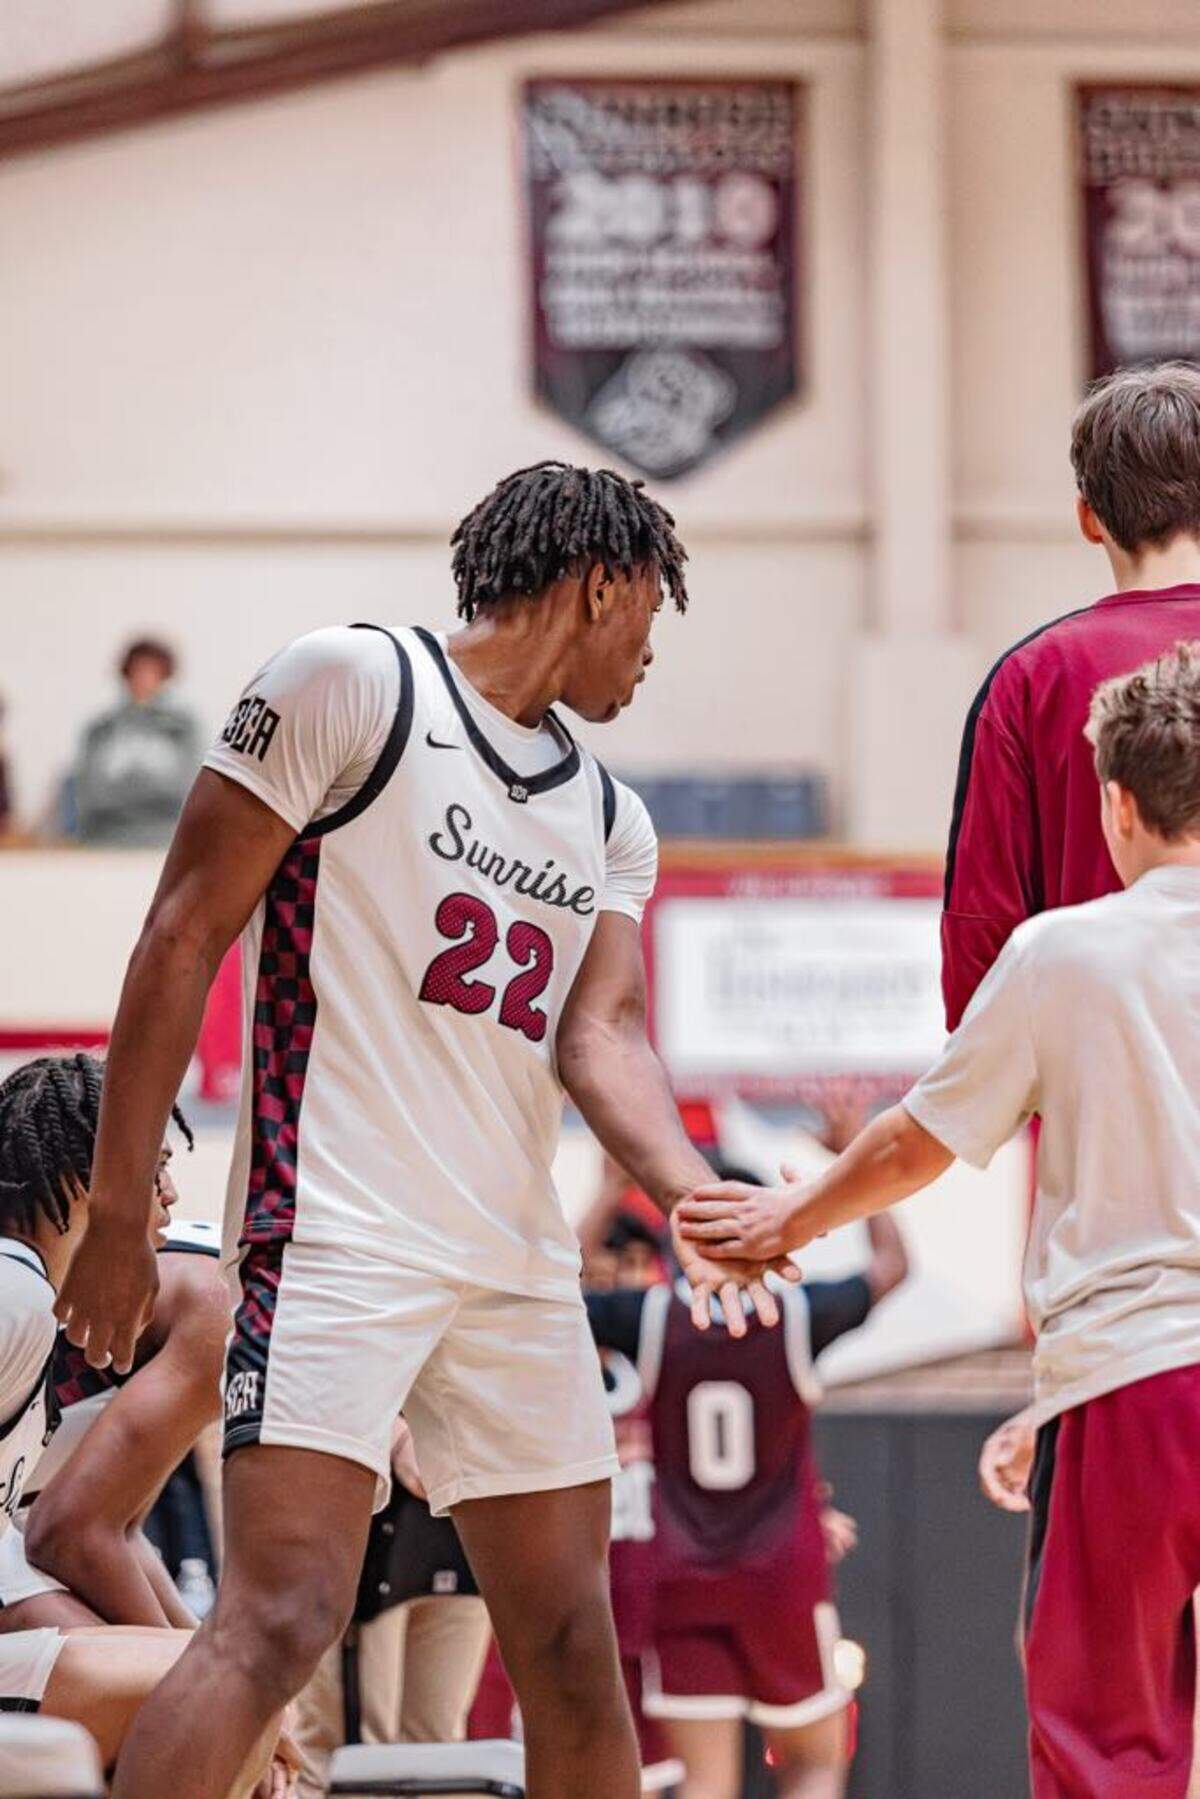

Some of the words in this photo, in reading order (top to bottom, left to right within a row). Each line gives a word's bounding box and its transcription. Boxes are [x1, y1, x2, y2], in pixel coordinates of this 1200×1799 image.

[429, 803, 595, 916] Sunrise
[418, 892, 554, 1042] 22
[687, 1380, 756, 1491] 0
